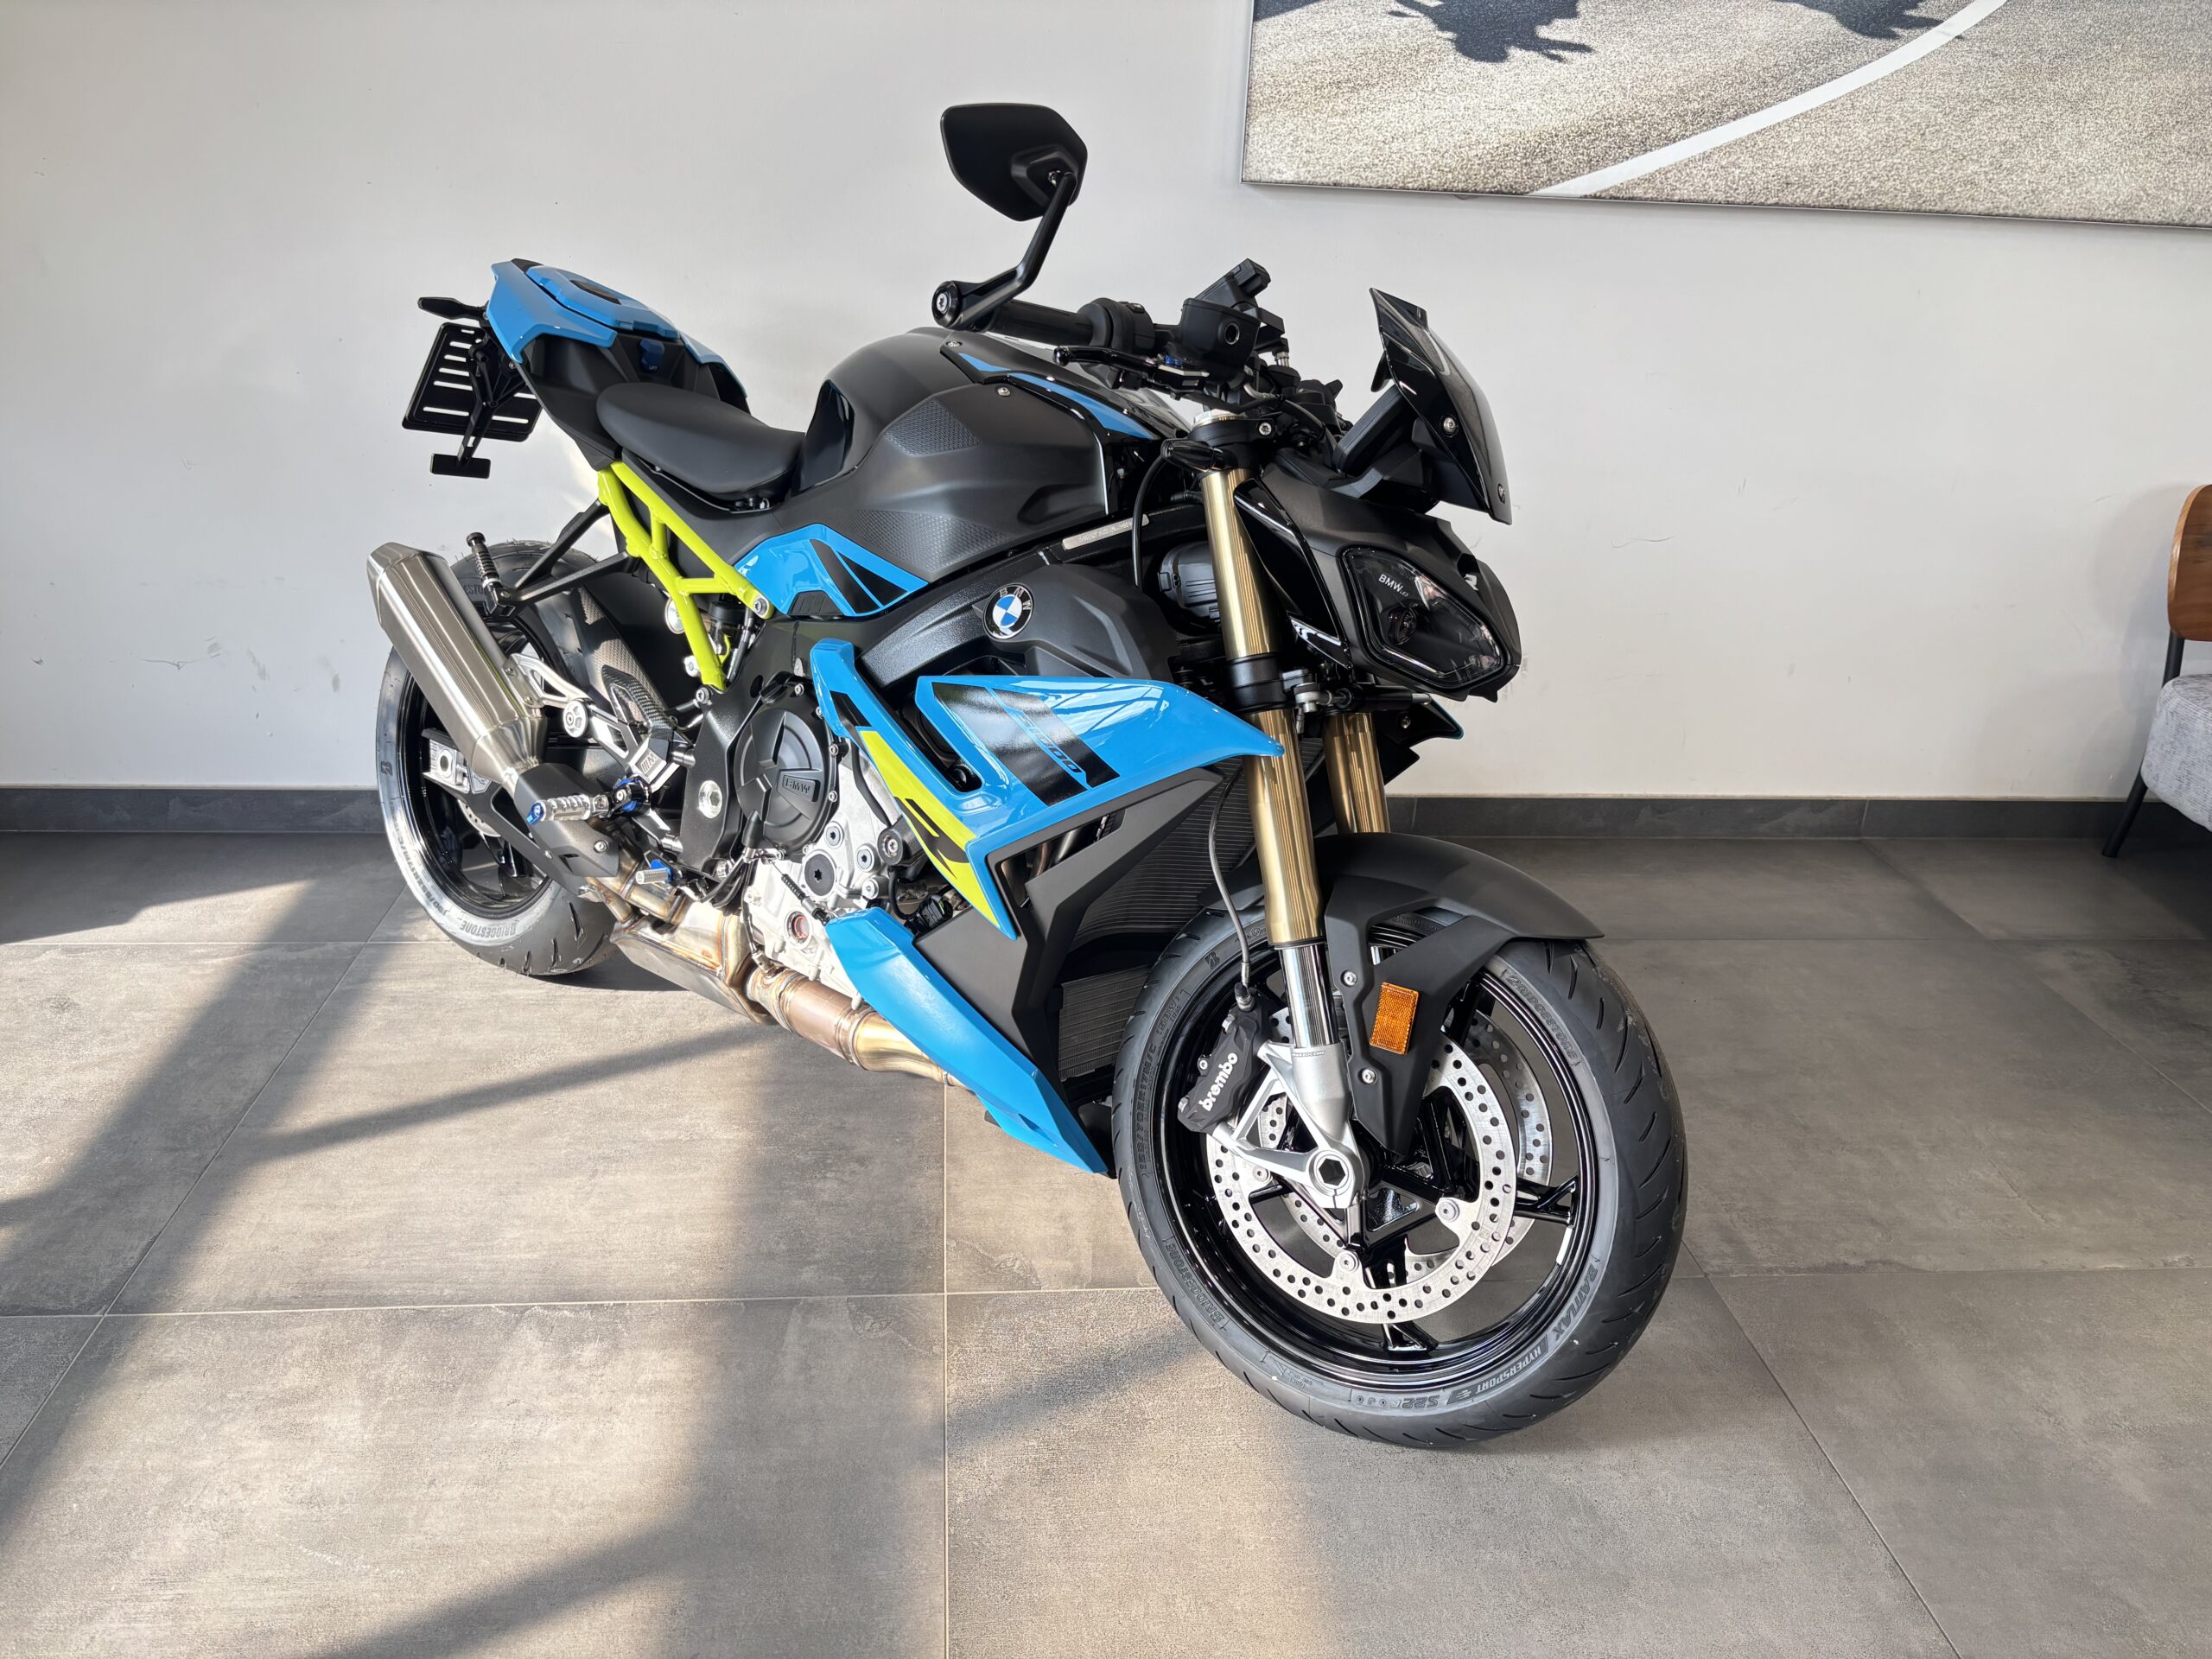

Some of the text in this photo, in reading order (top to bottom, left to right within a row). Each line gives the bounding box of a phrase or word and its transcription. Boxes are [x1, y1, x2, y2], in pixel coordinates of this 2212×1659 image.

[999, 587, 1033, 610] BMW
[1378, 574, 1402, 593] BMW
[460, 920, 518, 938] BRIDGESTONE
[1198, 1052, 1238, 1111] brembo
[1552, 1263, 1599, 1341] BATTLAX
[1475, 1345, 1542, 1394] HYPERSPORT
